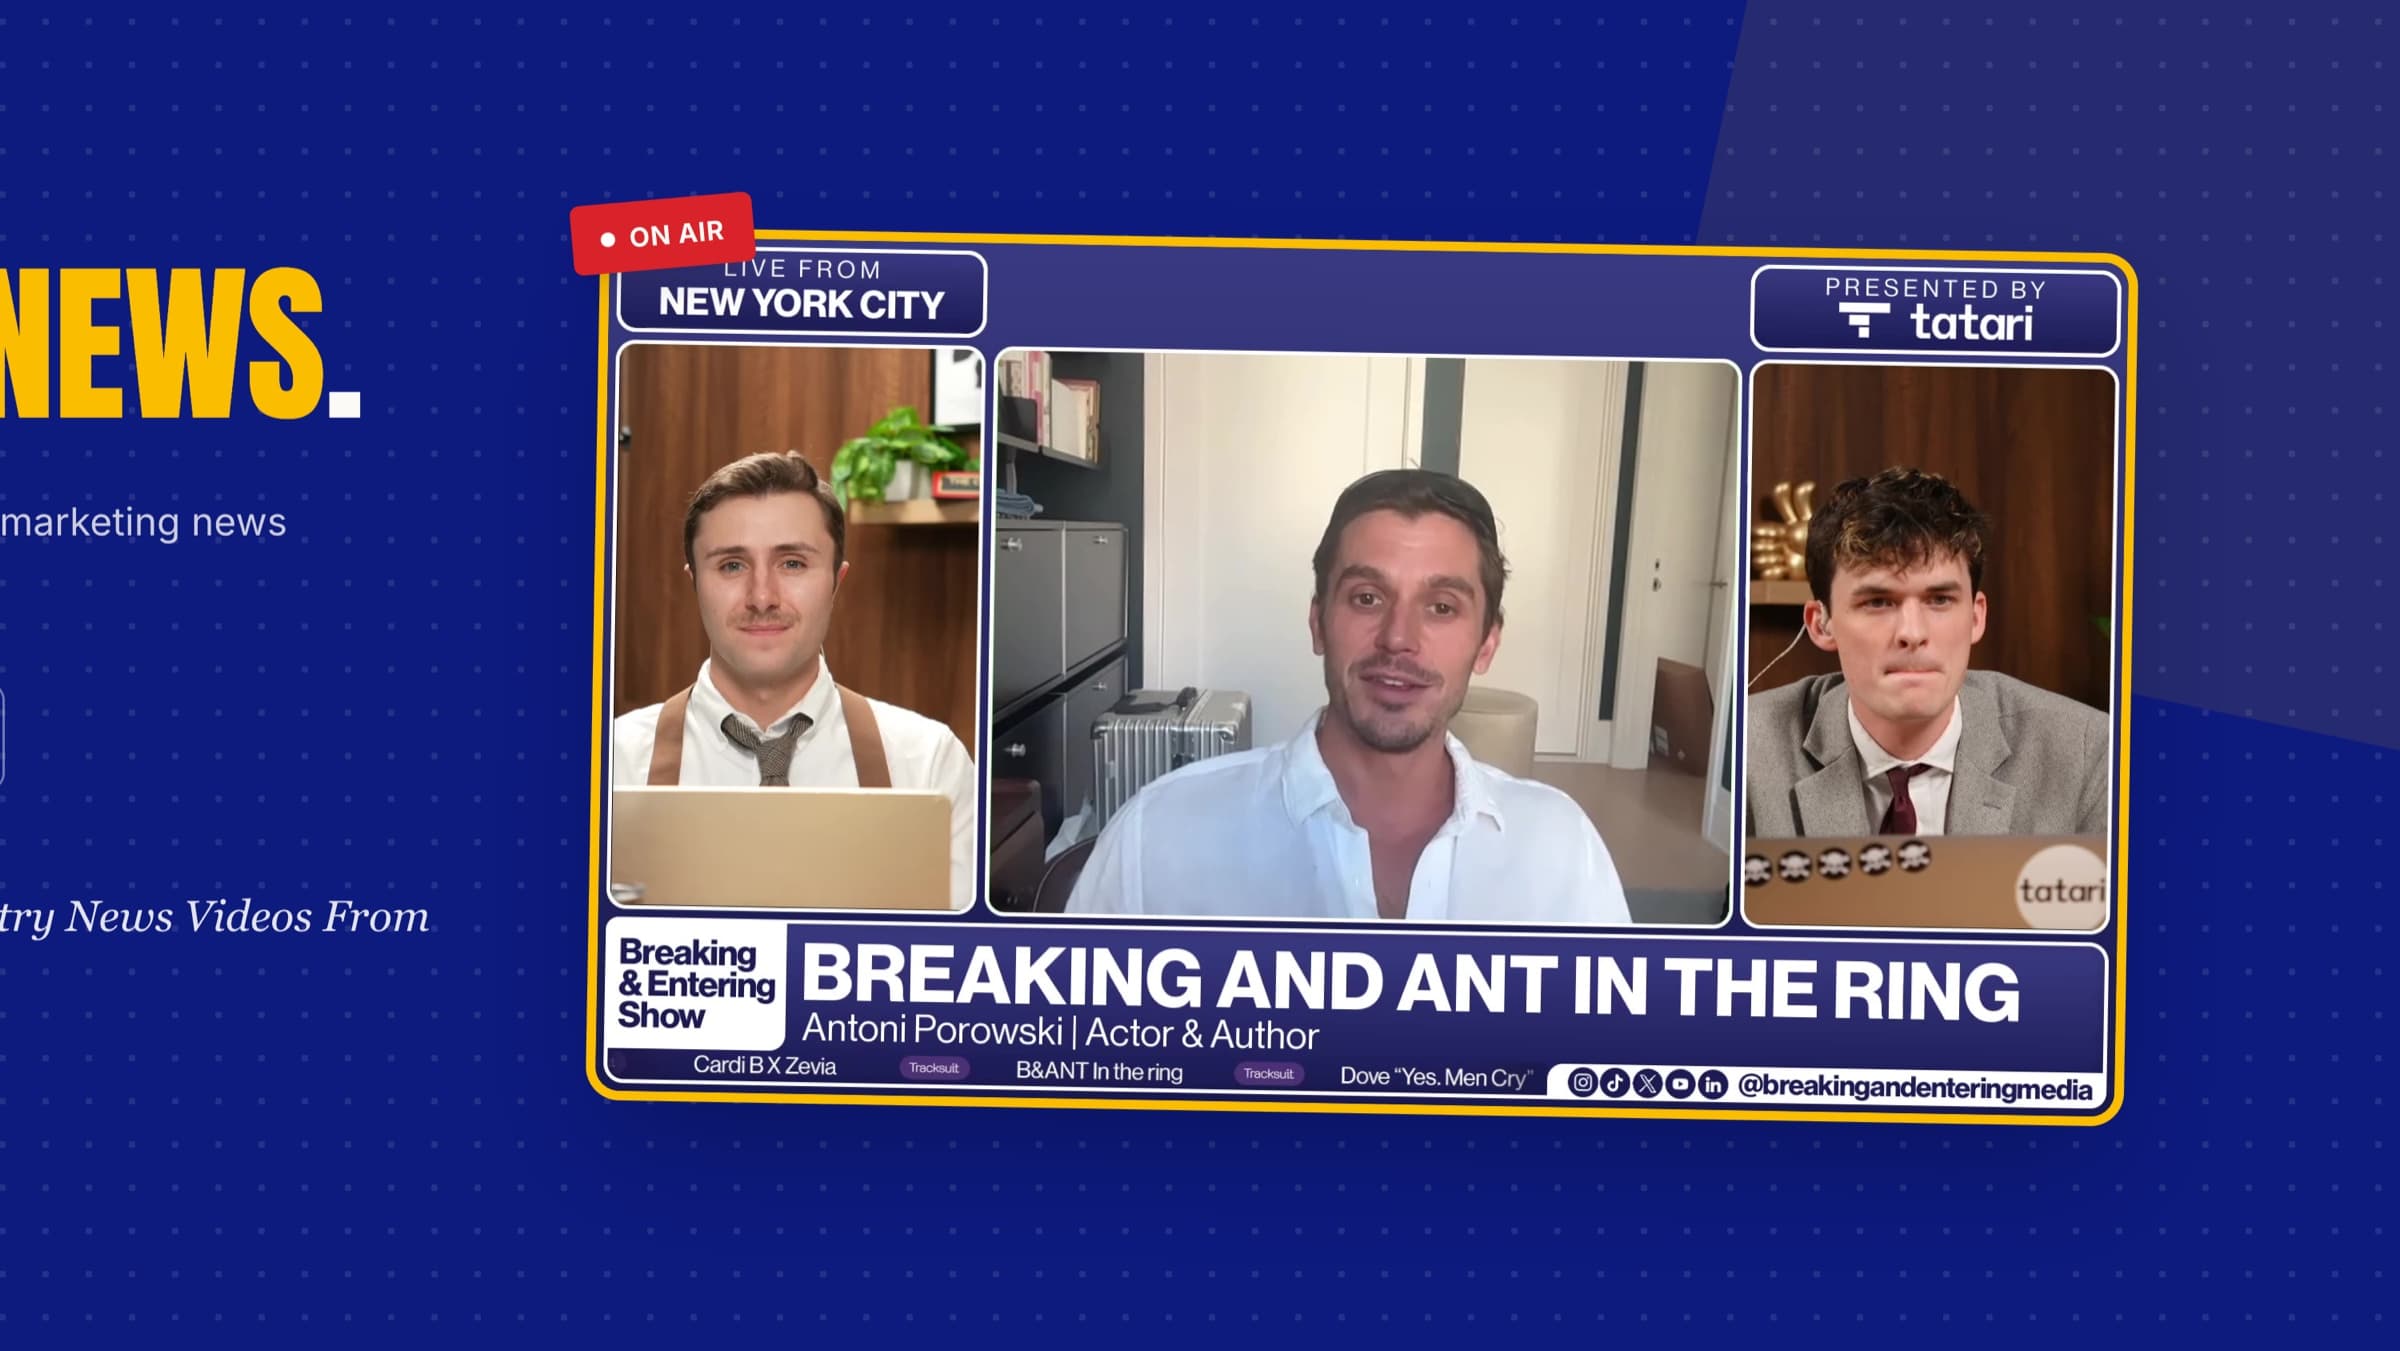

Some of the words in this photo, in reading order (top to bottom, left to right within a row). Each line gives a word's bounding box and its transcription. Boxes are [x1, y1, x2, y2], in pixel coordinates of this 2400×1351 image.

[629, 225, 671, 248] ON
[679, 220, 725, 245] AIR
[724, 258, 785, 278] LIVE
[799, 259, 880, 280] FROM
[659, 286, 746, 317] NEW
[752, 288, 854, 319] YORK
[860, 289, 946, 320] CITY
[1825, 277, 1999, 299] PRESENTED
[2011, 280, 2046, 300] BY
[1910, 303, 2034, 341] tatari
[0, 506, 180, 544] marketing
[193, 512, 287, 537] news
[2020, 878, 2105, 902] tatari
[65, 900, 174, 932] News
[187, 898, 312, 932] Videos
[322, 900, 430, 932] From
[619, 937, 758, 972] Breaking
[618, 970, 643, 997] &
[647, 971, 776, 1004] Entering
[803, 943, 1202, 1009] BREAKING
[1216, 949, 1384, 1010] AND
[1396, 952, 1559, 1014] ANT
[1574, 956, 1648, 1016] IN
[1664, 957, 1818, 1019] THE
[1834, 960, 2021, 1023] RING
[618, 1001, 707, 1030] Show
[802, 1012, 907, 1043] Antoni
[915, 1013, 1064, 1046] Porowski
[1086, 1017, 1175, 1048] Actor
[1182, 1019, 1204, 1049] &
[1211, 1019, 1320, 1051] Author
[693, 1055, 746, 1074] Cardi
[750, 1056, 764, 1074] B
[767, 1056, 782, 1075] X
[785, 1056, 838, 1076] Zevia
[909, 1061, 960, 1075] Tracksuit
[1016, 1060, 1089, 1080] B&ANT
[1093, 1062, 1108, 1081] In
[1113, 1062, 1143, 1081] the
[1147, 1063, 1183, 1086] ring
[1243, 1067, 1295, 1080] Tracksuit
[1340, 1066, 1391, 1085] Dove
[1445, 1068, 1487, 1087] Men
[1738, 1073, 2093, 1104] @breakingandenteringmedia
